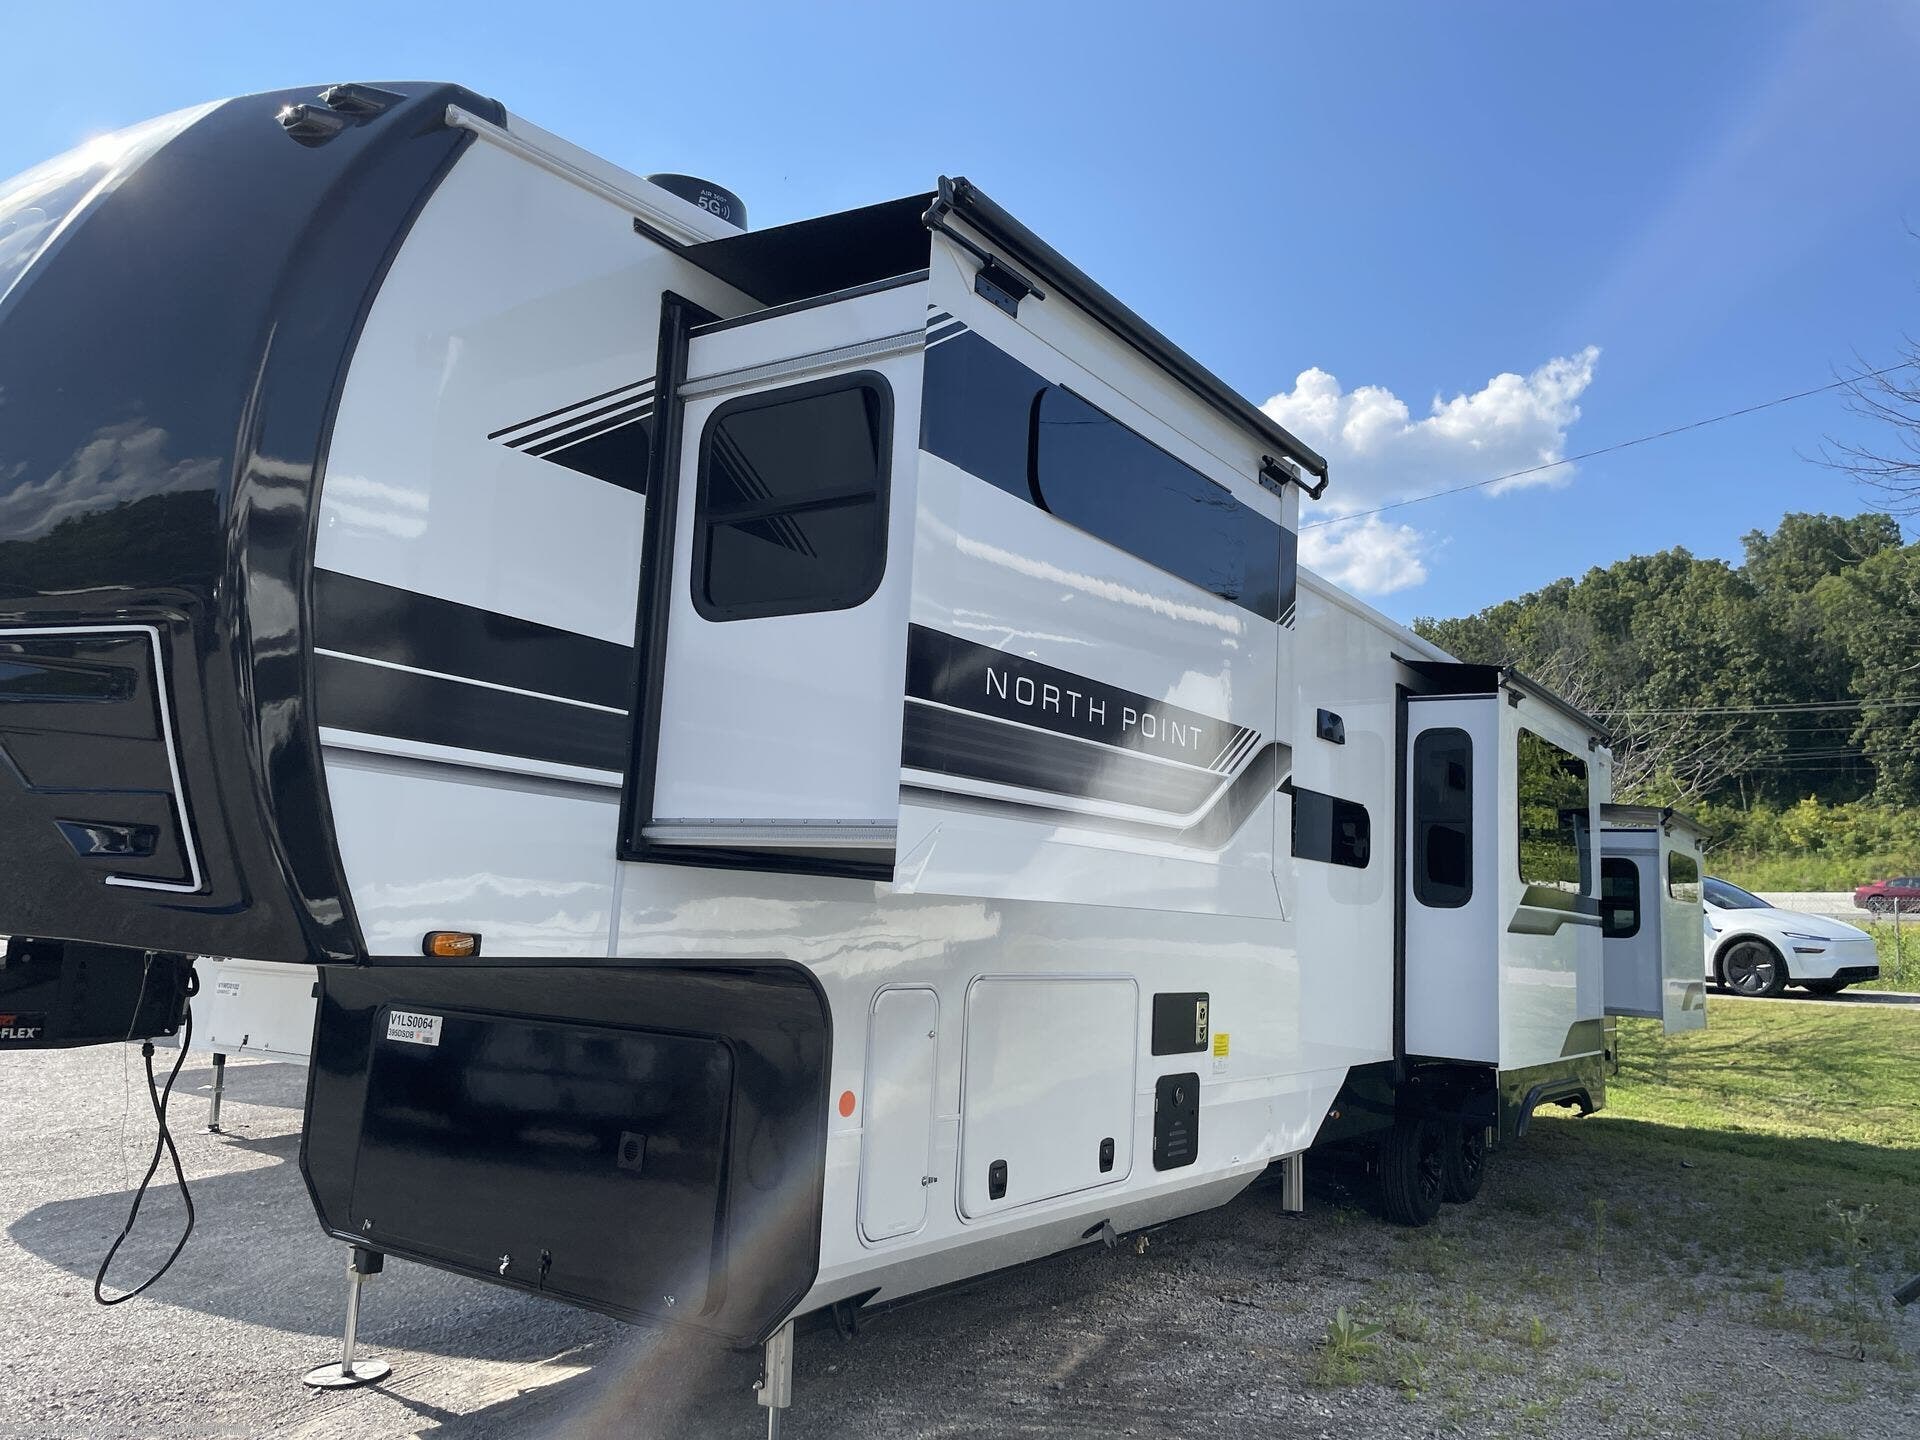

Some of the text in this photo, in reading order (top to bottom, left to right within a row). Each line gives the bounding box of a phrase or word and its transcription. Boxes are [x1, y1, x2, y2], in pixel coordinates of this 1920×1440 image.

[700, 189, 712, 197] AIR
[697, 196, 721, 215] 5G
[986, 667, 1203, 750] NORTH POINT
[391, 1013, 433, 1029] V1LS0064
